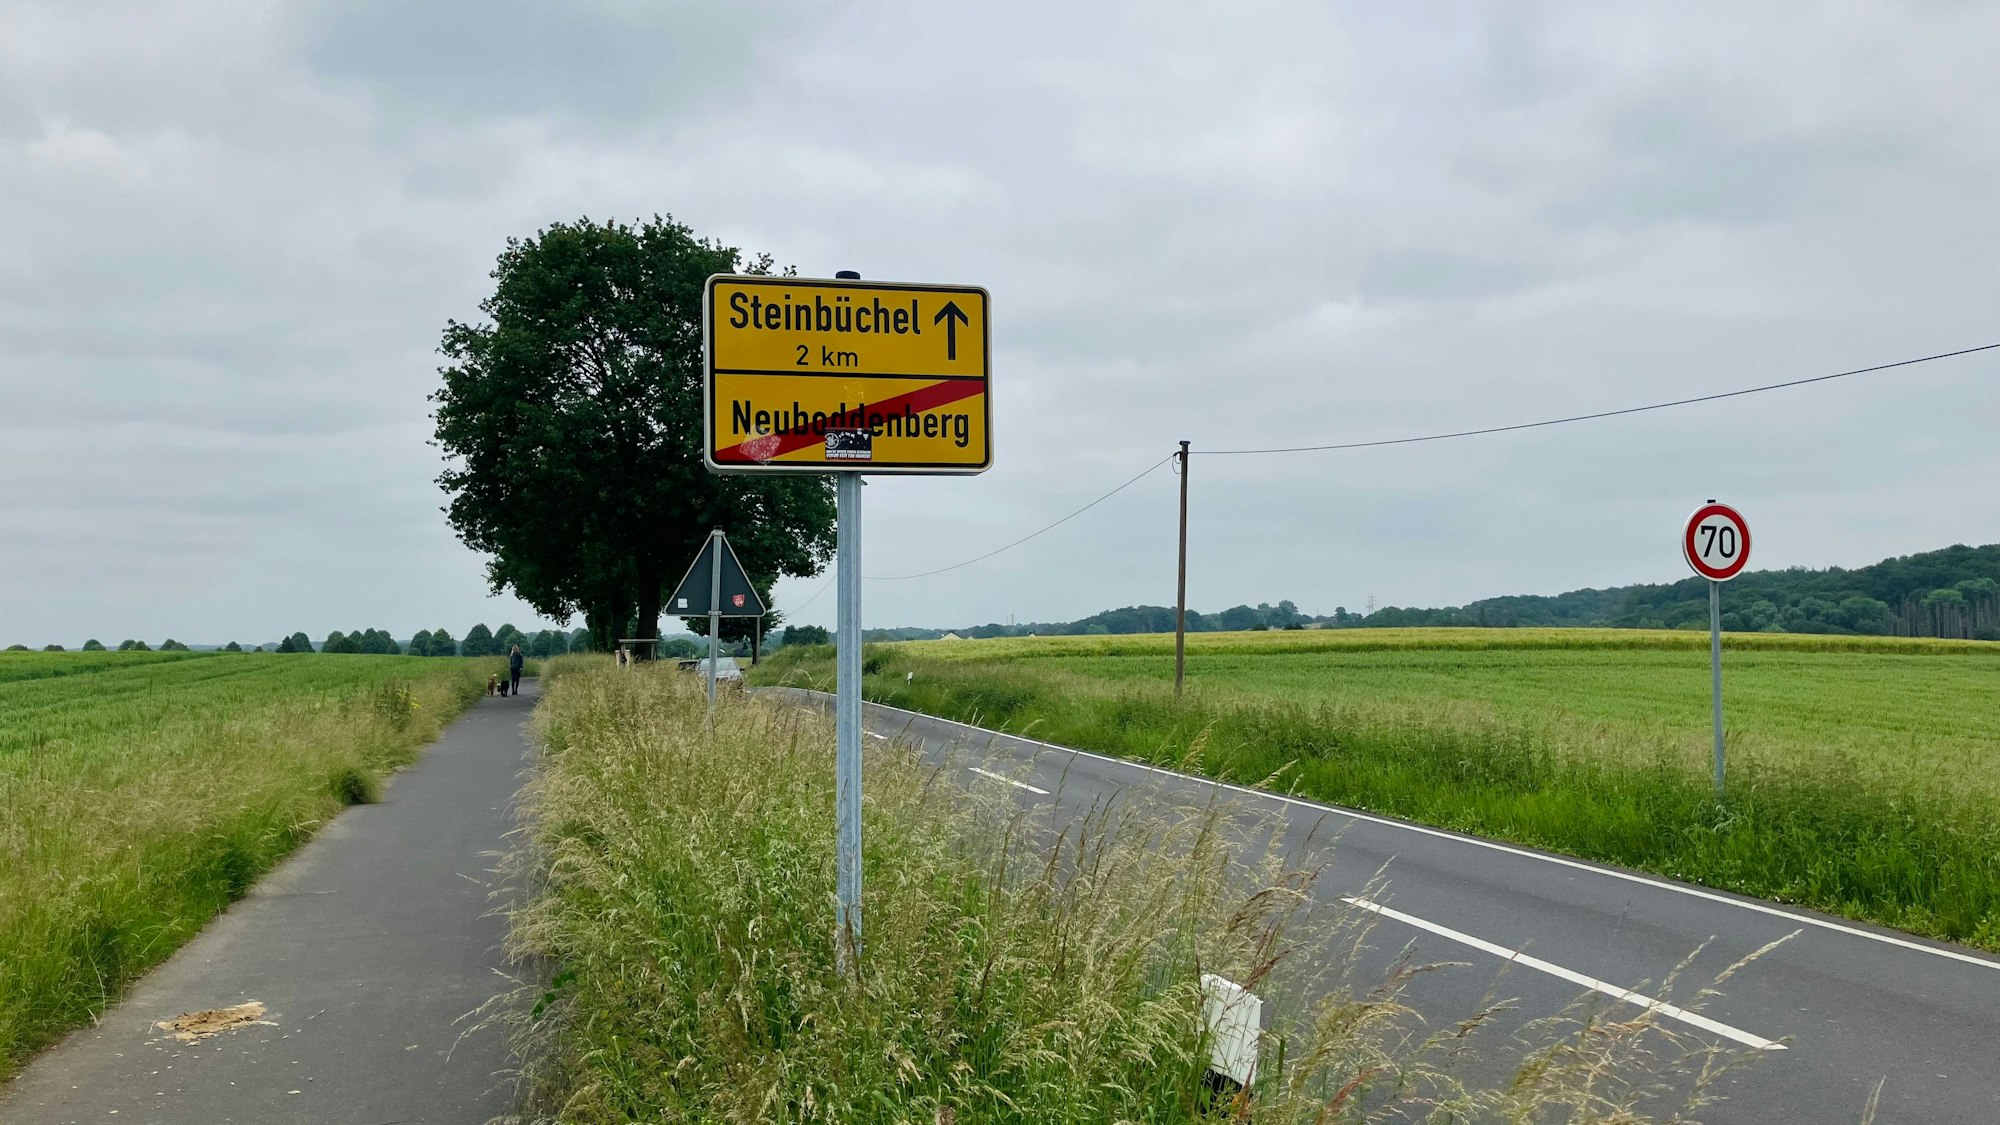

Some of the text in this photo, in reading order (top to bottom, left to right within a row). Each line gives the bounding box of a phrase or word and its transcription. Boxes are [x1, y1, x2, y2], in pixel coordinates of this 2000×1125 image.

[729, 291, 921, 335] Steinbüchel
[796, 344, 859, 367] 2 km
[732, 399, 969, 448] Neuboddenberg
[1701, 526, 1735, 558] 70
